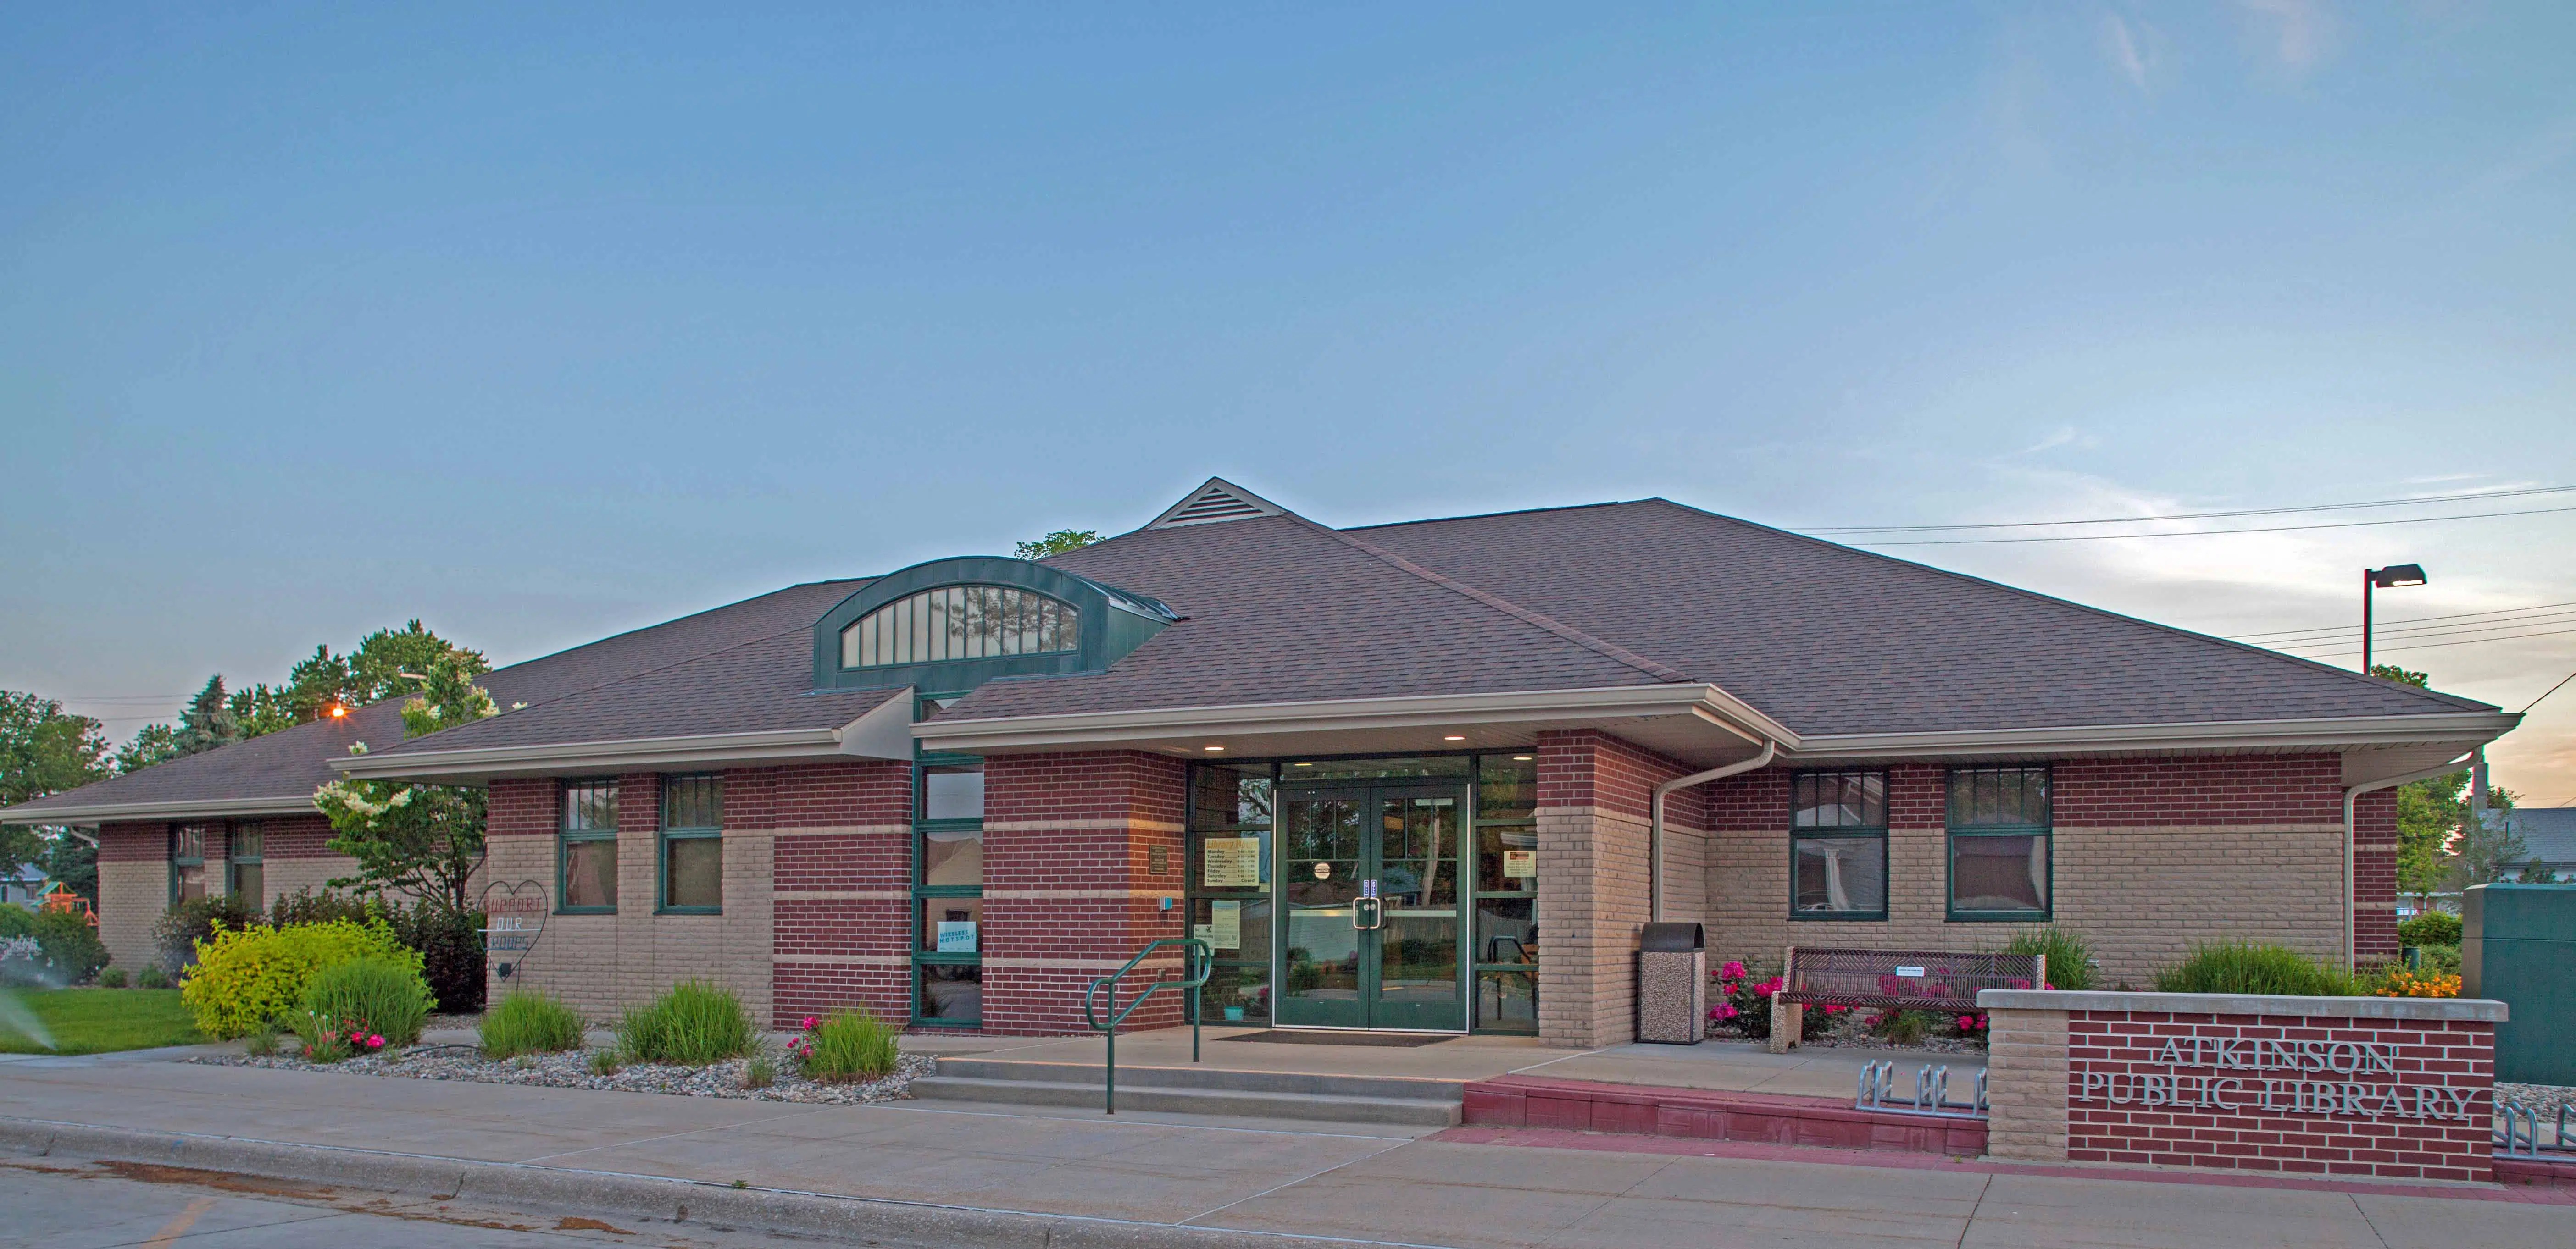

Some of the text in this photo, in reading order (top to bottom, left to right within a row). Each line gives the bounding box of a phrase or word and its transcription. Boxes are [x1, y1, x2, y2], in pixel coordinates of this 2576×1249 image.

[1206, 840, 1234, 850] Library
[484, 897, 541, 912] SUPPORT
[497, 917, 522, 931] OUR
[939, 934, 975, 943] HOTSPOT
[2155, 1037, 2398, 1075] ATKINSON
[2078, 1072, 2481, 1121] PUBLIC LIBRARY
